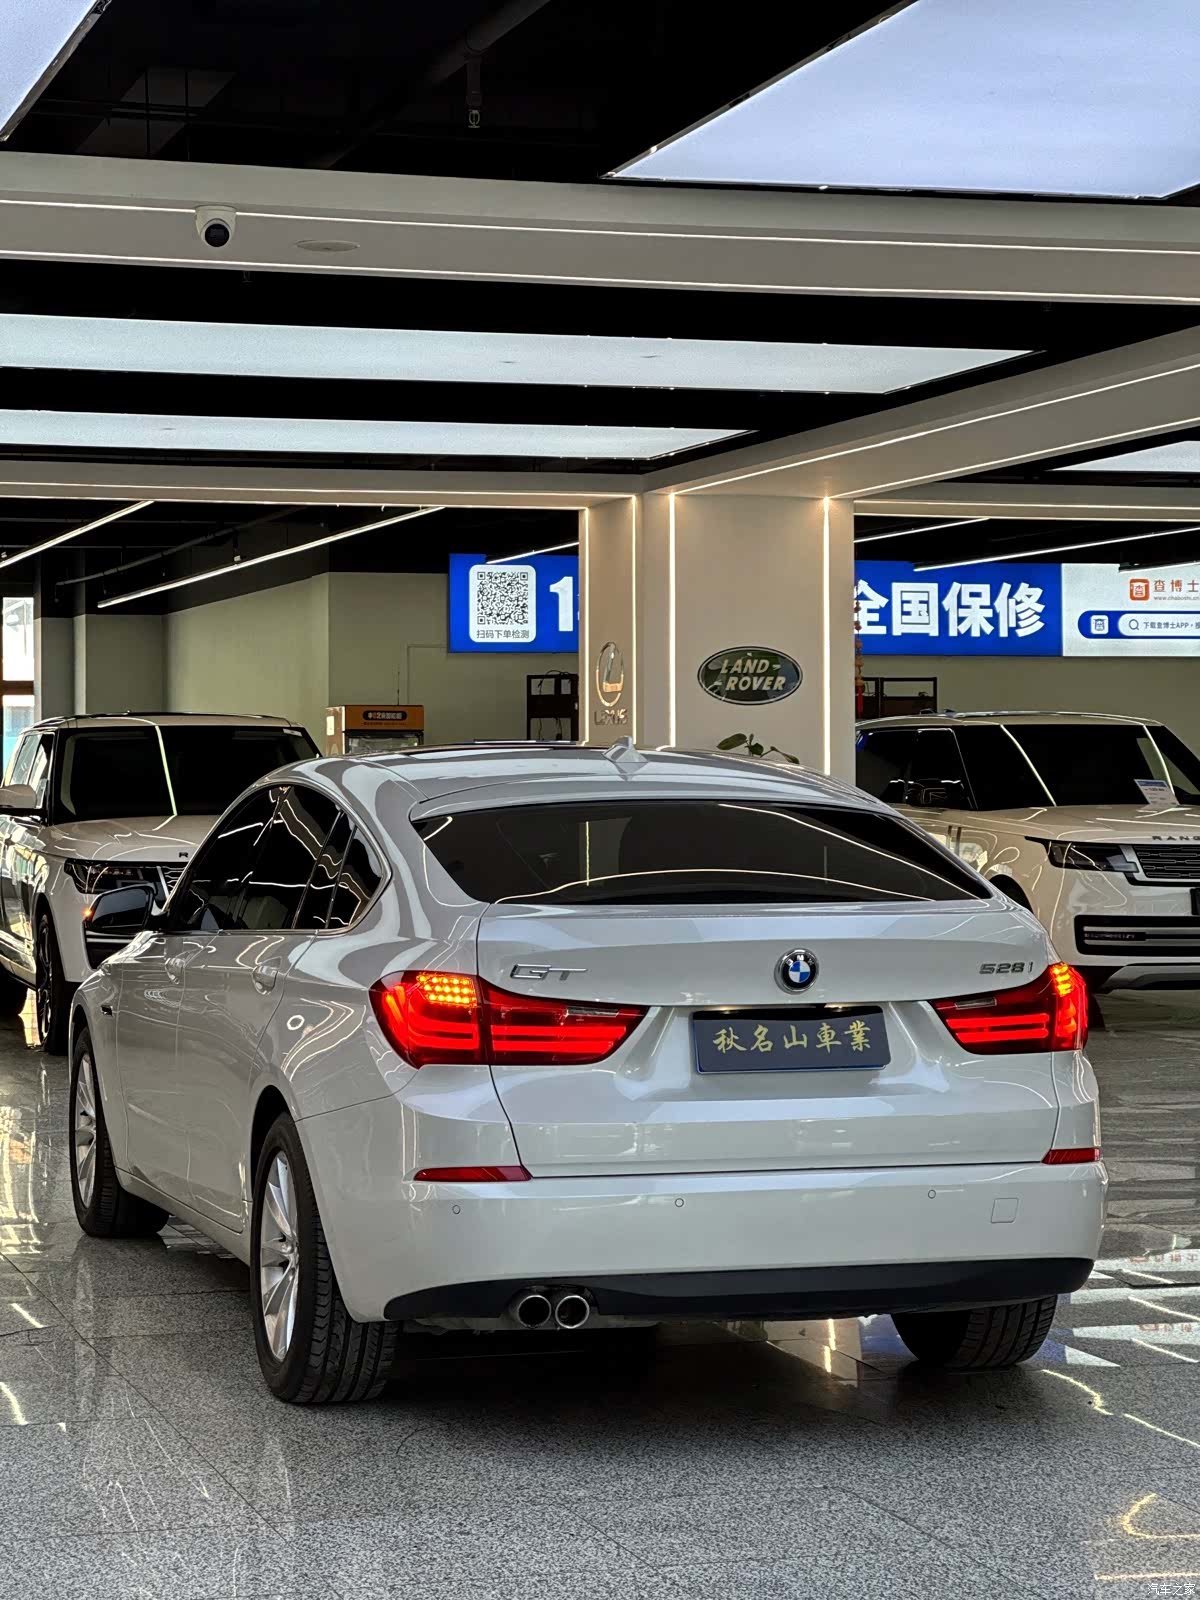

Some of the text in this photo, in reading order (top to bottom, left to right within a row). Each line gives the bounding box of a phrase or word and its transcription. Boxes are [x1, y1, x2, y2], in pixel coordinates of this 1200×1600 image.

[1153, 579, 1200, 593] 查博士
[854, 579, 1046, 638] 全国保修
[476, 629, 530, 639] 扫码下单检测
[720, 658, 770, 674] LAND
[725, 675, 787, 691] ROVER
[509, 963, 588, 980] GT
[712, 1020, 871, 1053] 秋名山車業
